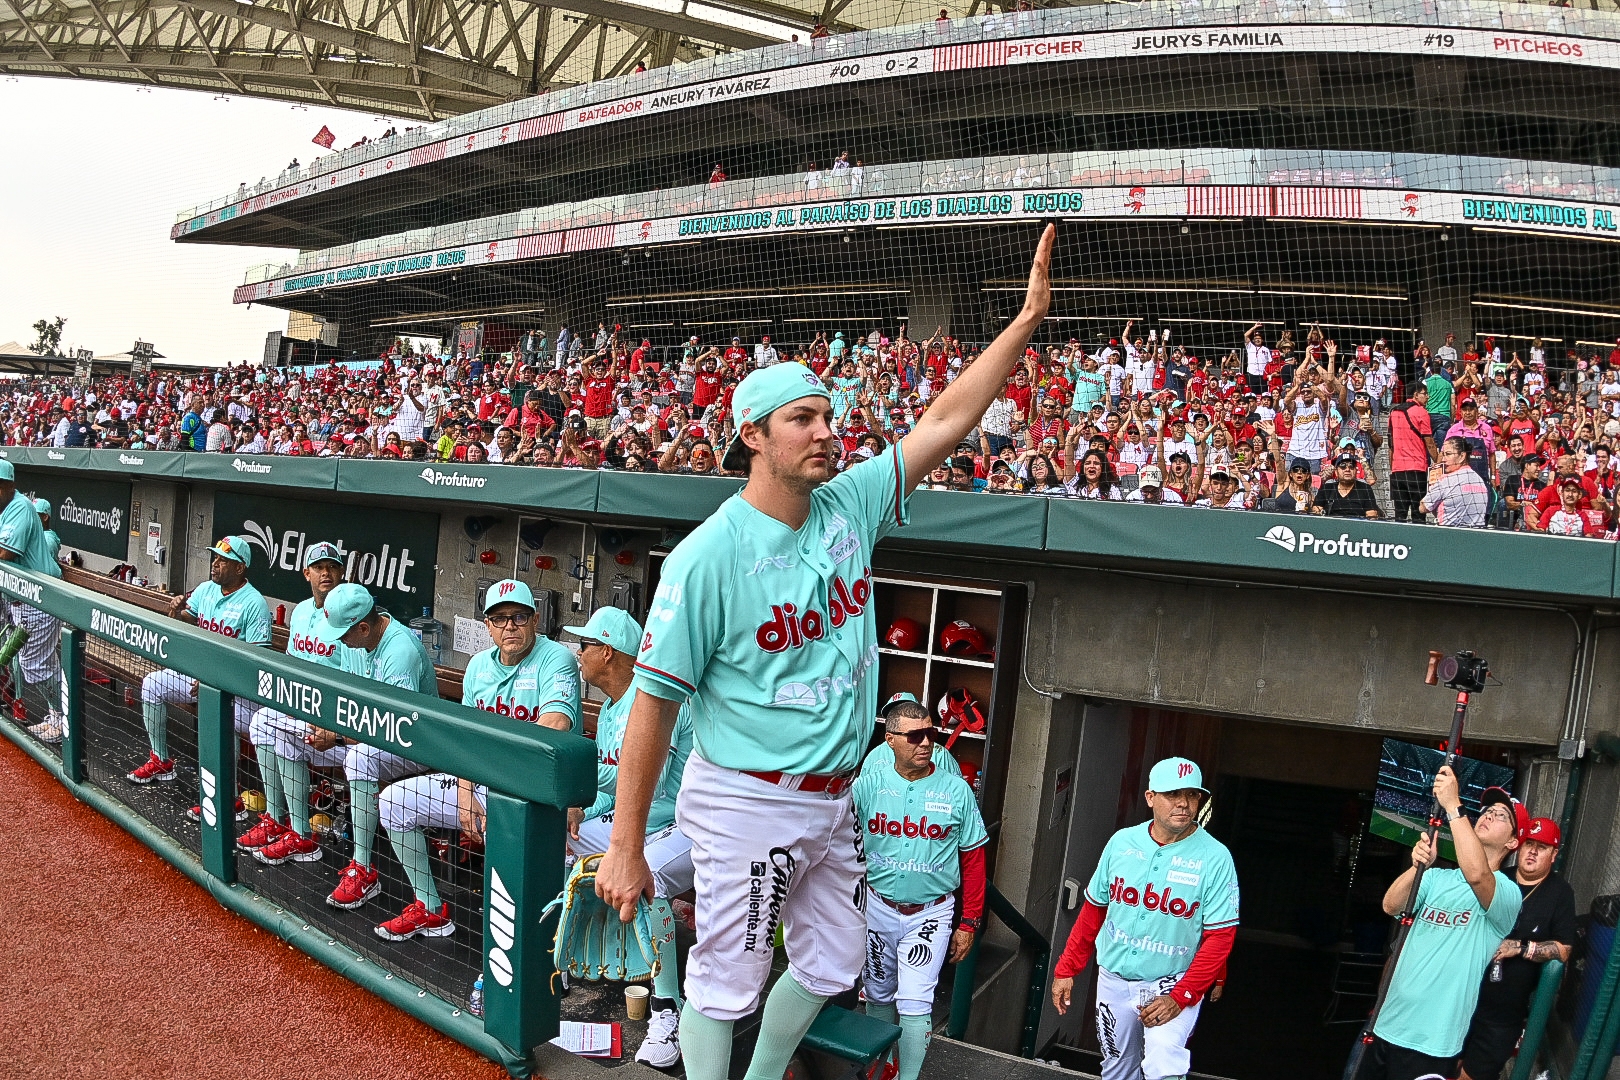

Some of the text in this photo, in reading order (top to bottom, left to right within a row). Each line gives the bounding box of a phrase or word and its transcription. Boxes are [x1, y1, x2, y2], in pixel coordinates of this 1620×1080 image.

[1007, 32, 1583, 59] PITCHER JEURYS FAMILIA #19 PITCHEOS
[578, 100, 643, 123] BATEADOR
[650, 88, 704, 109] ANEURY
[708, 77, 771, 98] TAVÁREZ
[829, 64, 860, 78] #00
[270, 187, 299, 203] ENTRADA
[679, 193, 1083, 235] BIENVENIDOS AL PARAÍSO DE LOS DIABLOS ROJOS
[1462, 199, 1618, 231] BIENVENIDOS AL
[381, 261, 396, 274] LOS
[397, 255, 433, 273] DIABLOS
[436, 250, 467, 268] ROJOS
[241, 461, 272, 473] Profuturo
[434, 471, 488, 488] Profuturo
[60, 497, 111, 530] citibanamex
[1298, 532, 1411, 560] Profuturo
[754, 564, 872, 653] diablo
[867, 811, 953, 841] diablos
[1169, 872, 1197, 884] Lenovo
[1109, 876, 1201, 921] diablos
[743, 878, 764, 953] caliente.mx
